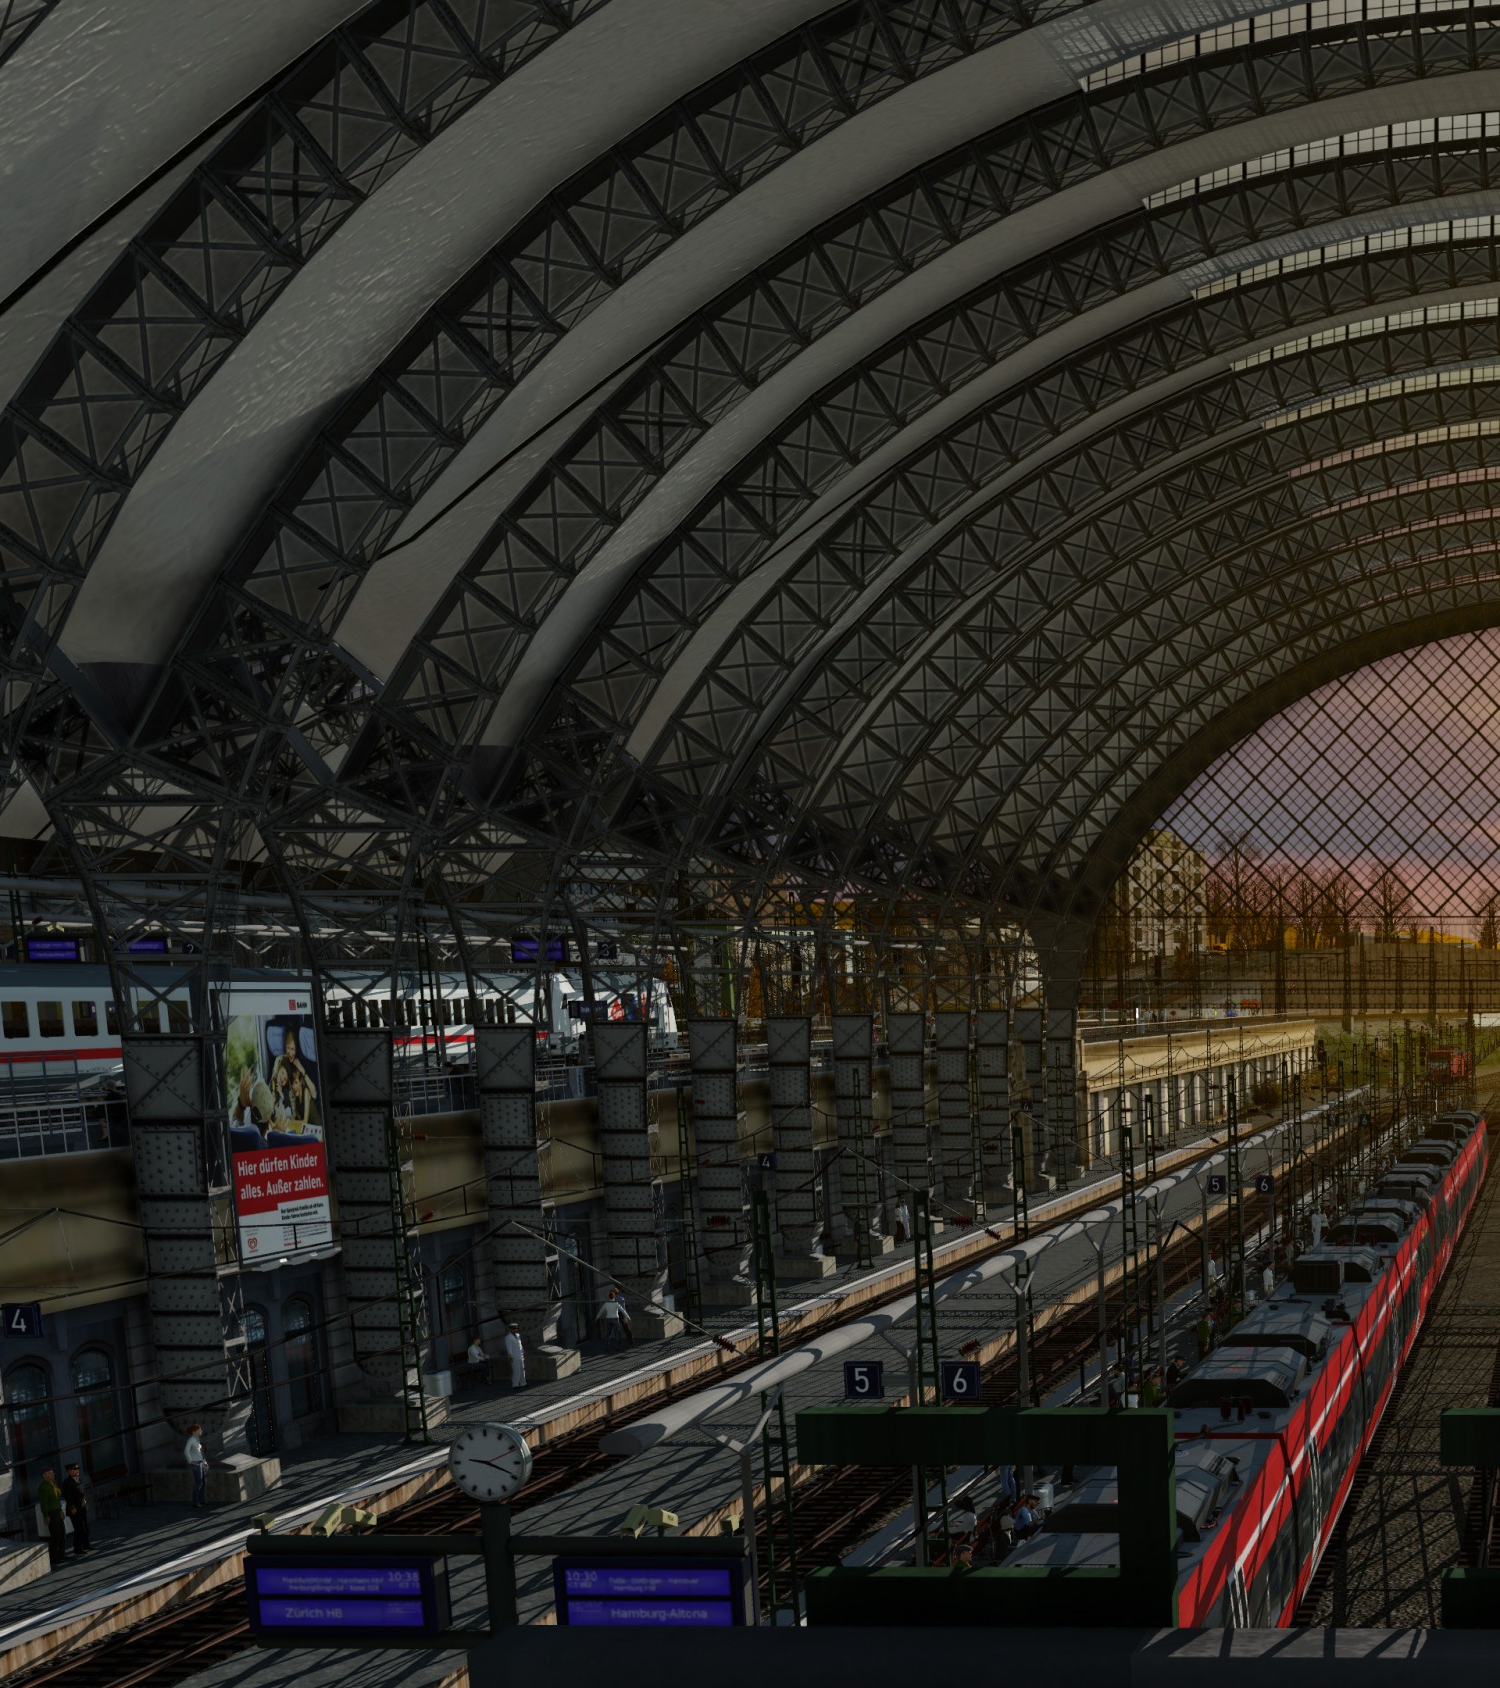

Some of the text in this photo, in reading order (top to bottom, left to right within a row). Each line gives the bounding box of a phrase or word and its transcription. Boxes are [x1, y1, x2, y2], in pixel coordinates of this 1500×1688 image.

[237, 1153, 318, 1176] Hier dürfen Kinder
[241, 1174, 324, 1200] alles. Außer zahlen.
[1211, 1179, 1220, 1191] 5
[1260, 1179, 1269, 1191] 6
[12, 1308, 27, 1334] 4
[854, 1367, 870, 1393] 5
[952, 1367, 968, 1394] 6
[387, 1571, 419, 1583] 10:38
[566, 1571, 598, 1582] 10:30
[284, 1607, 343, 1619] Zürich HB
[610, 1608, 708, 1622] Hamburg-Altona
